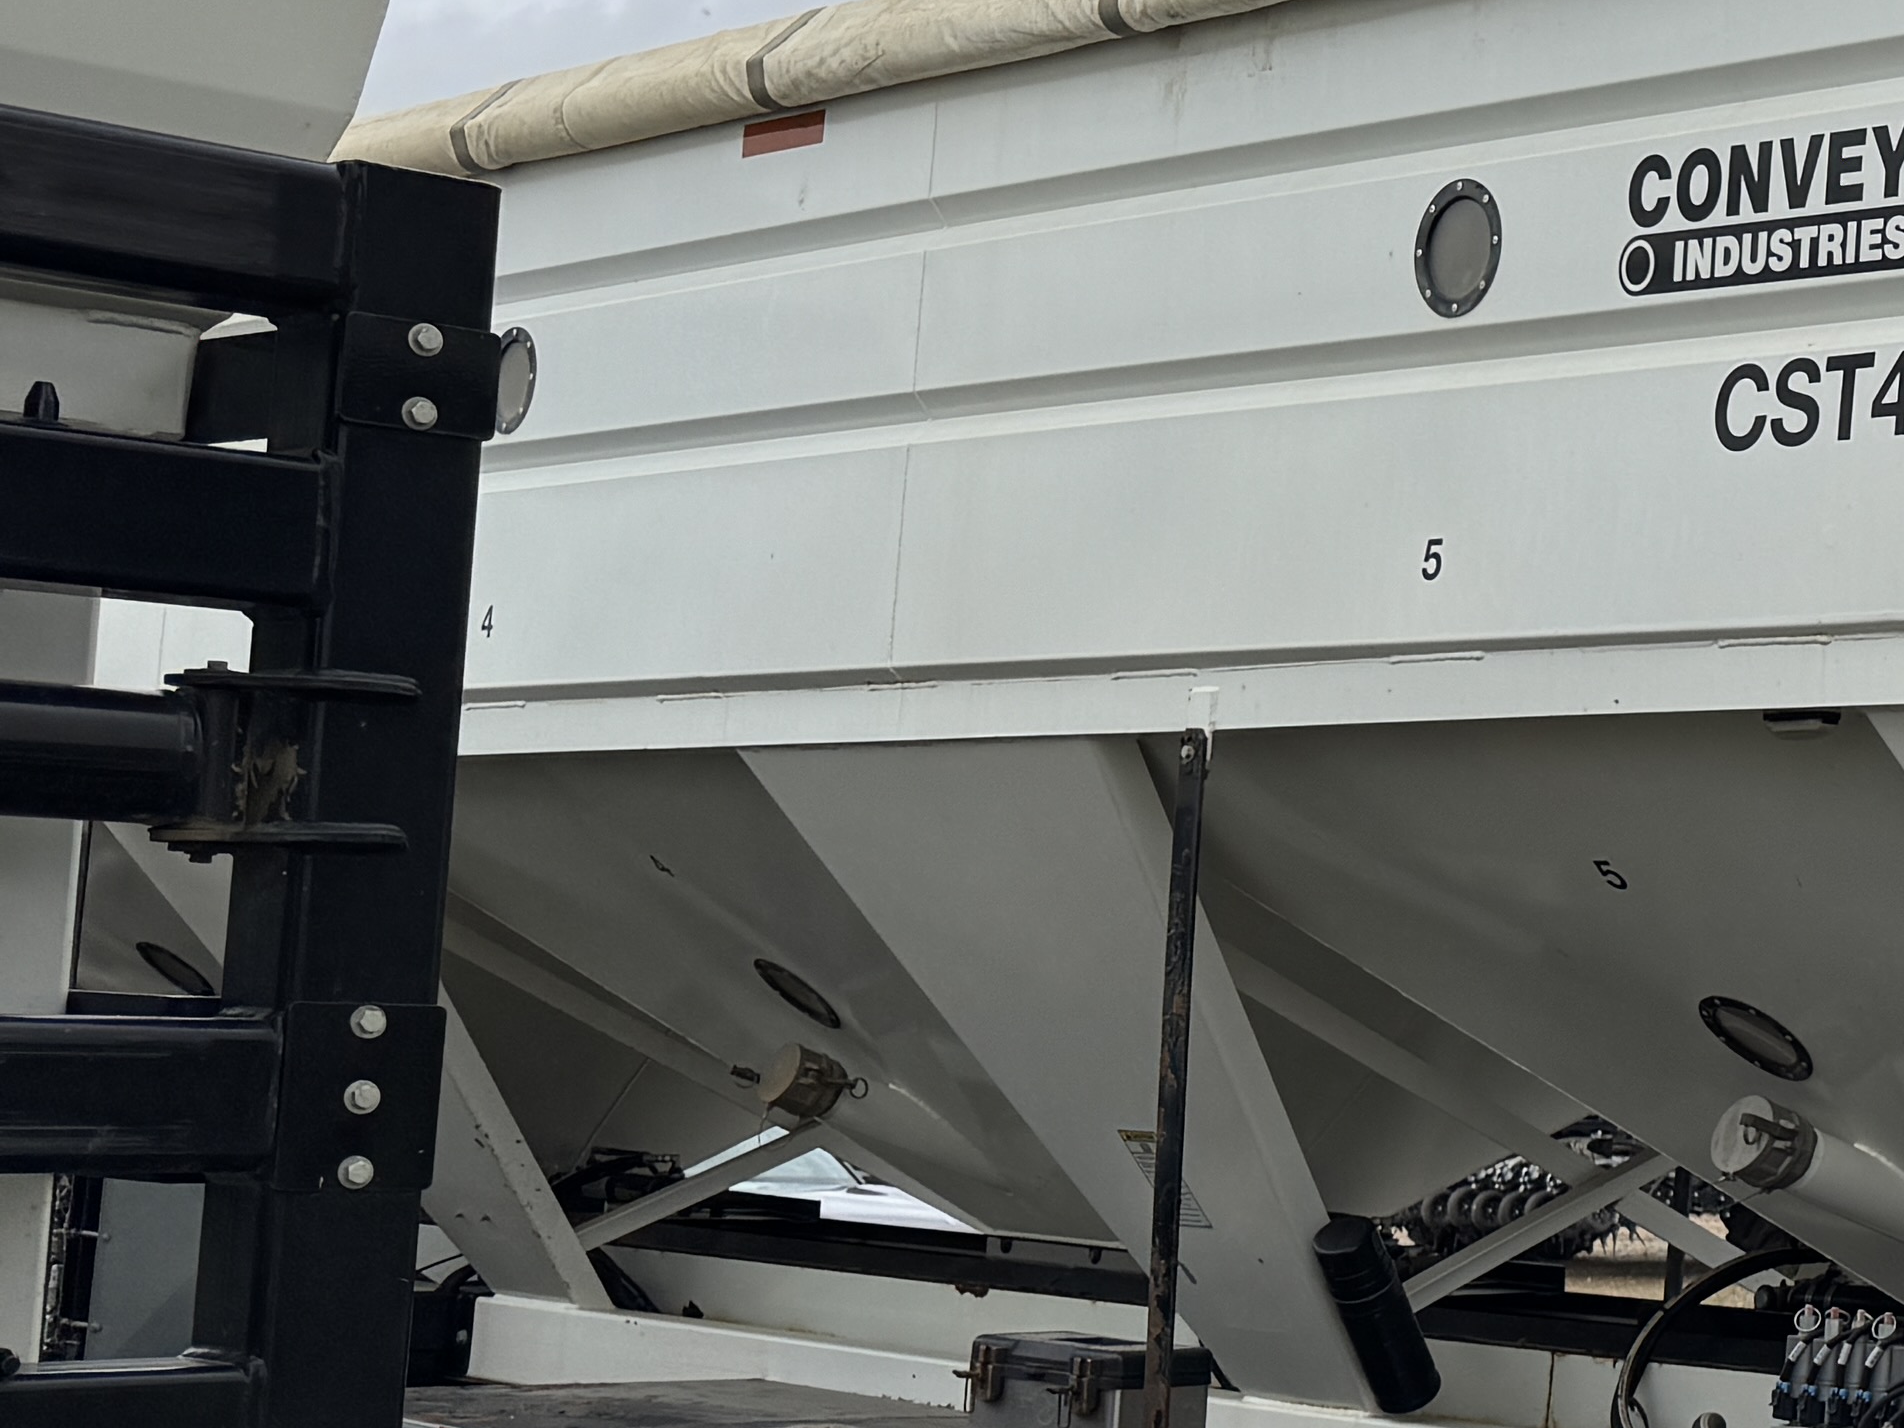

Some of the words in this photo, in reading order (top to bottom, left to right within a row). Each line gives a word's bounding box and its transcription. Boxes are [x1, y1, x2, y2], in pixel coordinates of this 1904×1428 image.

[1421, 538, 1443, 581] 5
[481, 605, 493, 638] 4
[1593, 860, 1627, 890] 5
